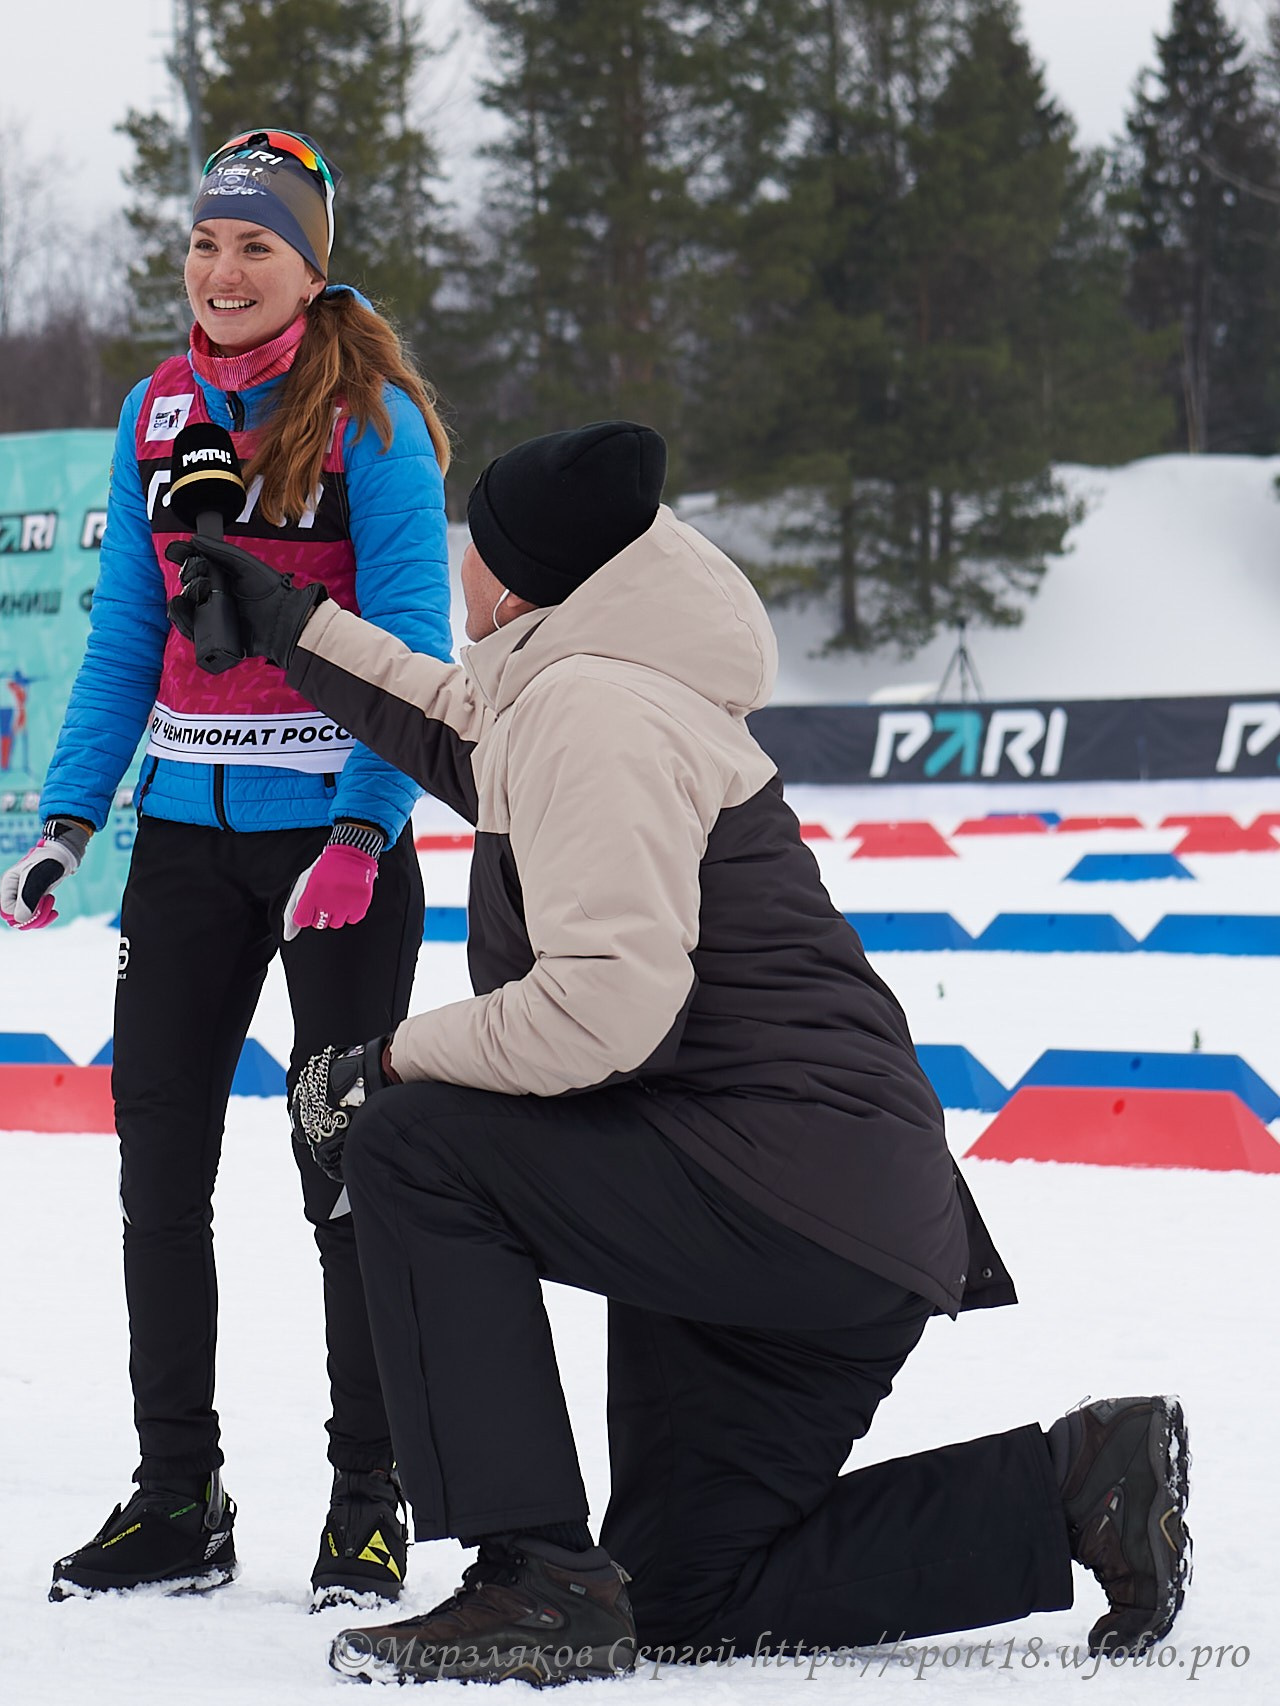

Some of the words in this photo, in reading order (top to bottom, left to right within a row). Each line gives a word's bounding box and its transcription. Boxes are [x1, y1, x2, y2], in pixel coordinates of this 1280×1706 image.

[163, 722, 276, 746] ЧЕМПИОНАТ
[280, 724, 356, 745] РОСС
[870, 708, 1068, 778] PARI
[203, 1530, 231, 1560] adidas
